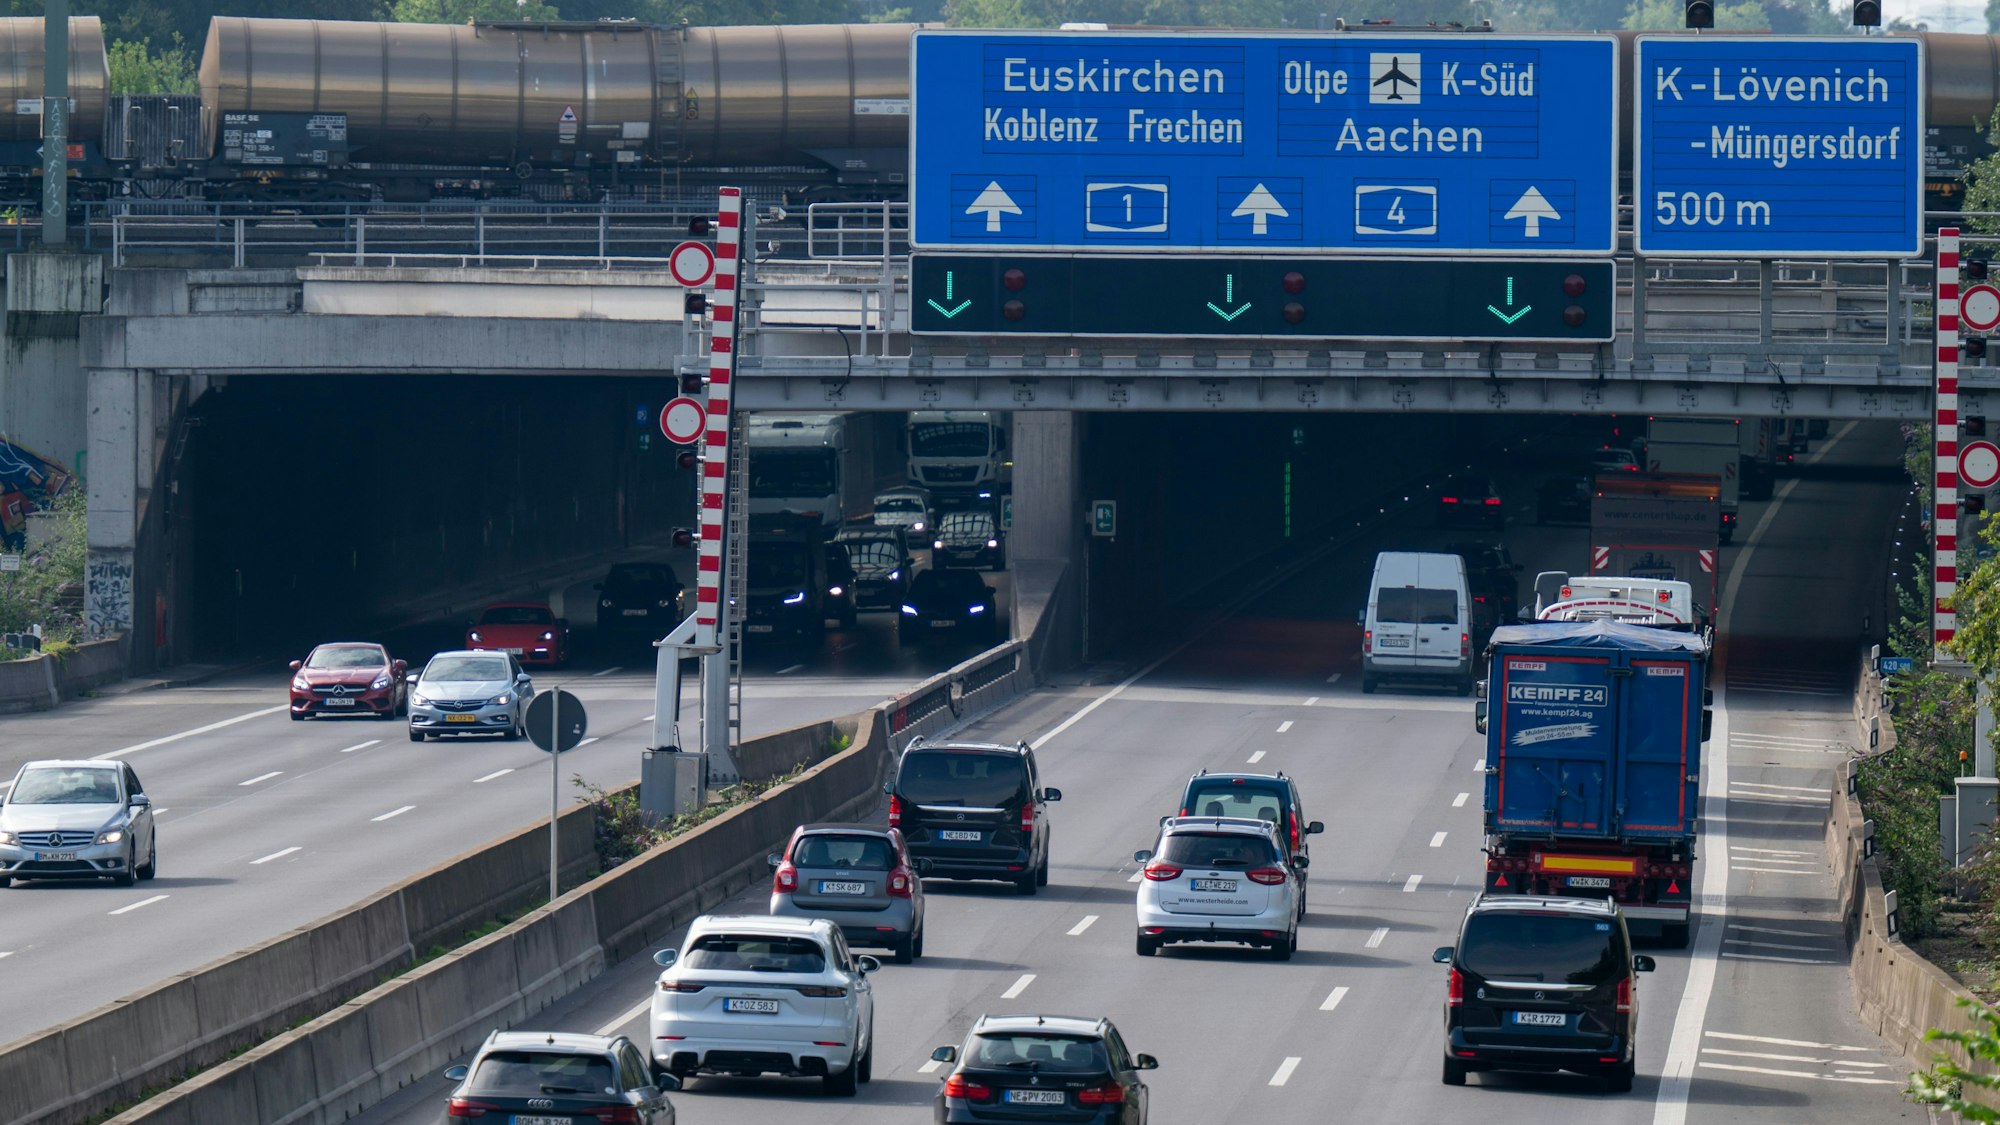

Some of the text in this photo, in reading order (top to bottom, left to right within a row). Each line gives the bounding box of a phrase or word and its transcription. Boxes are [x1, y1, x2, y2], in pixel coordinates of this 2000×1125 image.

[1005, 59, 1224, 93] Euskirchen
[1285, 61, 1533, 102] Olpe K-Süd
[985, 109, 1242, 143] Koblenz Frechen
[1336, 118, 1482, 152] Aachen
[1691, 125, 1900, 168] -Müngersdorf
[1122, 194, 1132, 222] 1
[1387, 197, 1405, 224] 4
[1657, 192, 1770, 225] 500 m
[1604, 511, 1706, 523] www.centershop.de
[1883, 661, 1898, 670] 420
[1511, 687, 1604, 702] KEMPF 24
[1521, 708, 1592, 719] www.kempf24.ag
[1525, 725, 1582, 737] Muldenvermietung
[836, 883, 846, 891] SK
[847, 884, 862, 892] 687
[1213, 881, 1222, 889] WE
[1223, 882, 1236, 890] 219
[1591, 879, 1610, 887] 3474
[1178, 897, 1249, 906] www.westerheide.com
[732, 1001, 738, 1009] K
[757, 1001, 774, 1011] 583
[1521, 1013, 1562, 1024] K R 1772
[1011, 1091, 1021, 1100] NE
[1040, 1093, 1062, 1102] 2003
